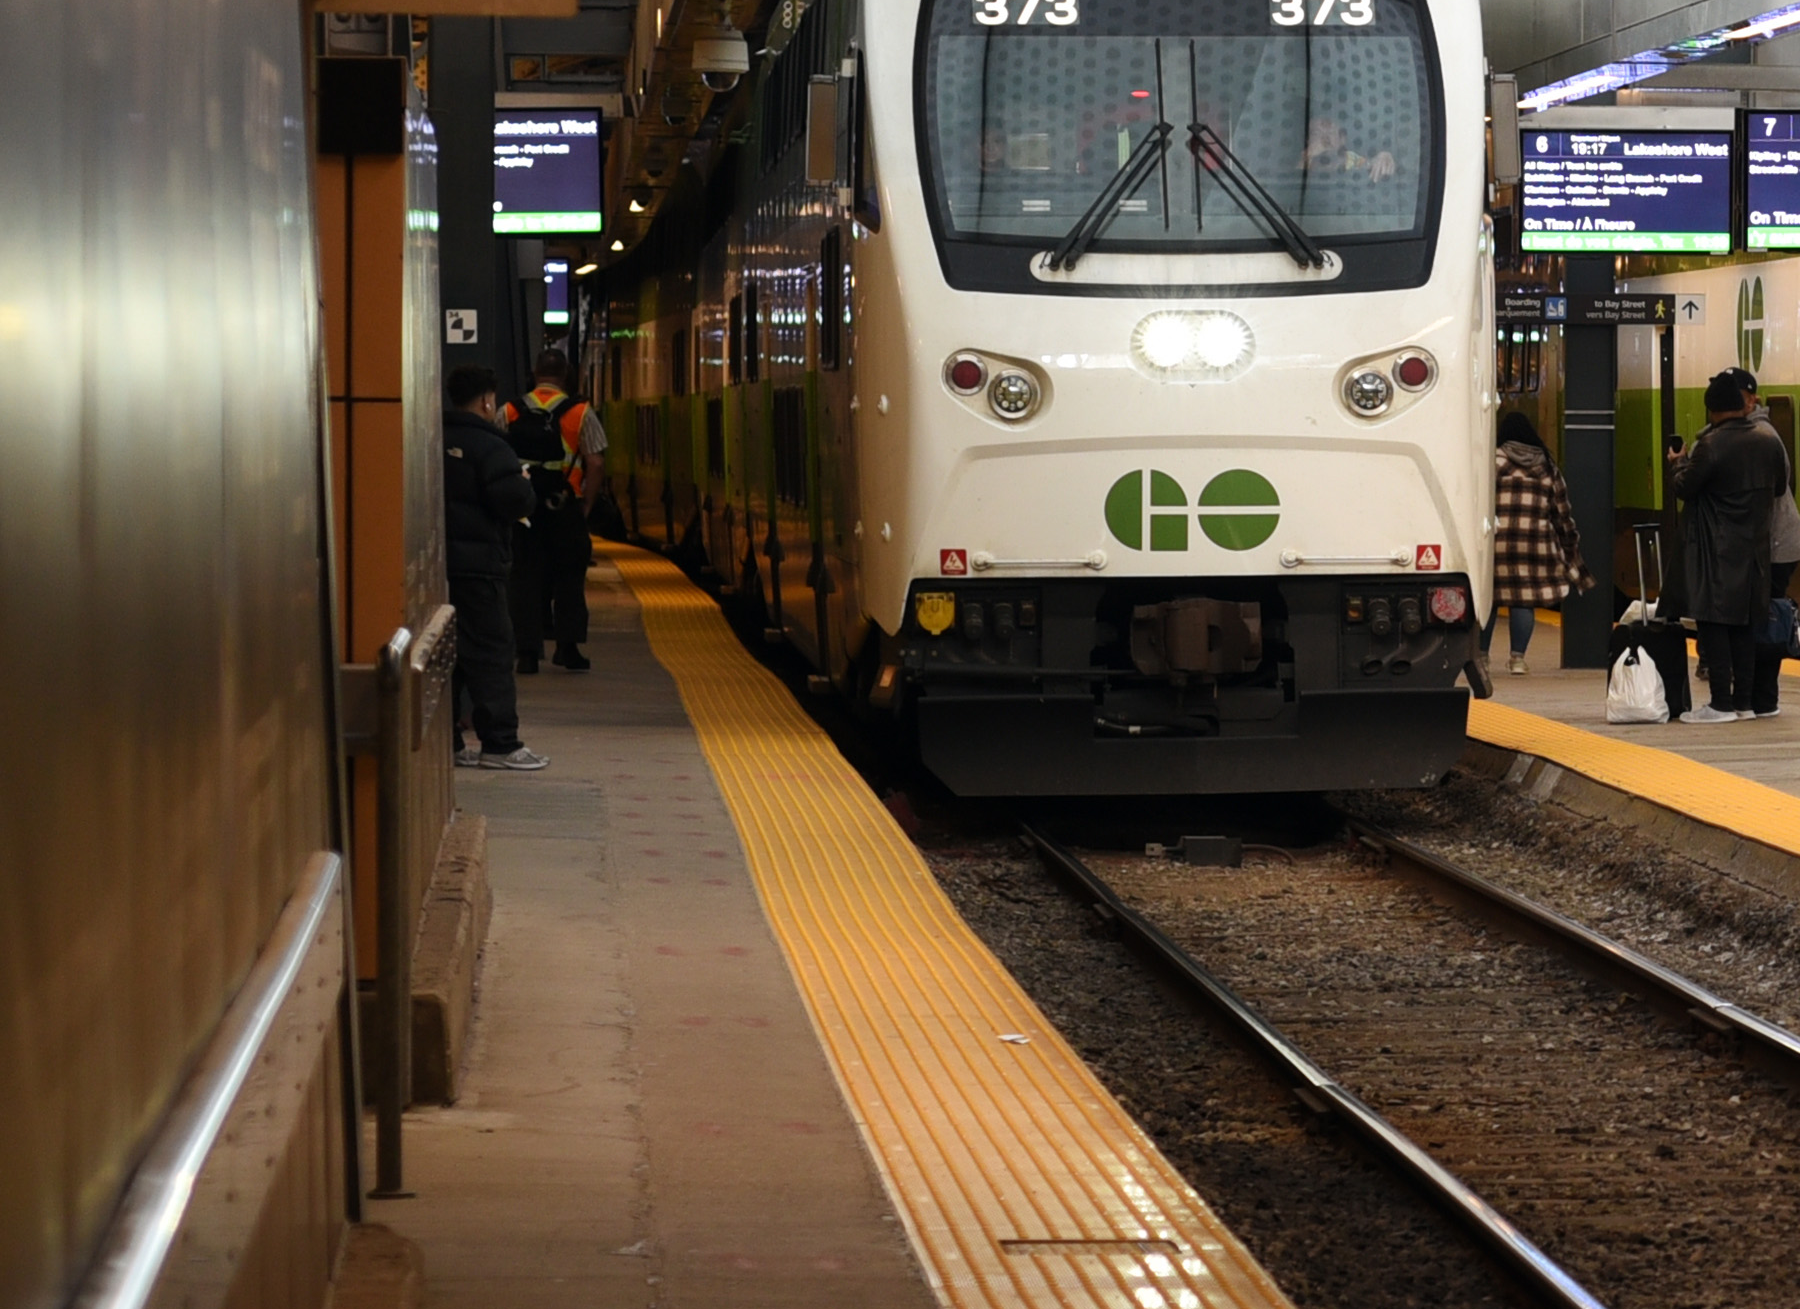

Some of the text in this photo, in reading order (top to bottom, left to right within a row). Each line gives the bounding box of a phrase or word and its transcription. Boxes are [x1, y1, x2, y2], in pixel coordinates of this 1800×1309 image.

[561, 121, 597, 134] West
[1763, 118, 1777, 136] 7
[1536, 136, 1548, 153] 6
[1571, 143, 1607, 155] 19:17
[1624, 143, 1729, 156] Lakeshore West
[1524, 219, 1542, 230] On
[1544, 219, 1574, 230] Time
[1582, 217, 1592, 230] À
[1595, 219, 1635, 230] l'heure
[1751, 212, 1770, 224] On
[1505, 298, 1540, 311] Boarding
[1594, 299, 1646, 311] to Bay Street
[1586, 310, 1646, 322] vers Bay Street
[1104, 468, 1281, 552] GO
